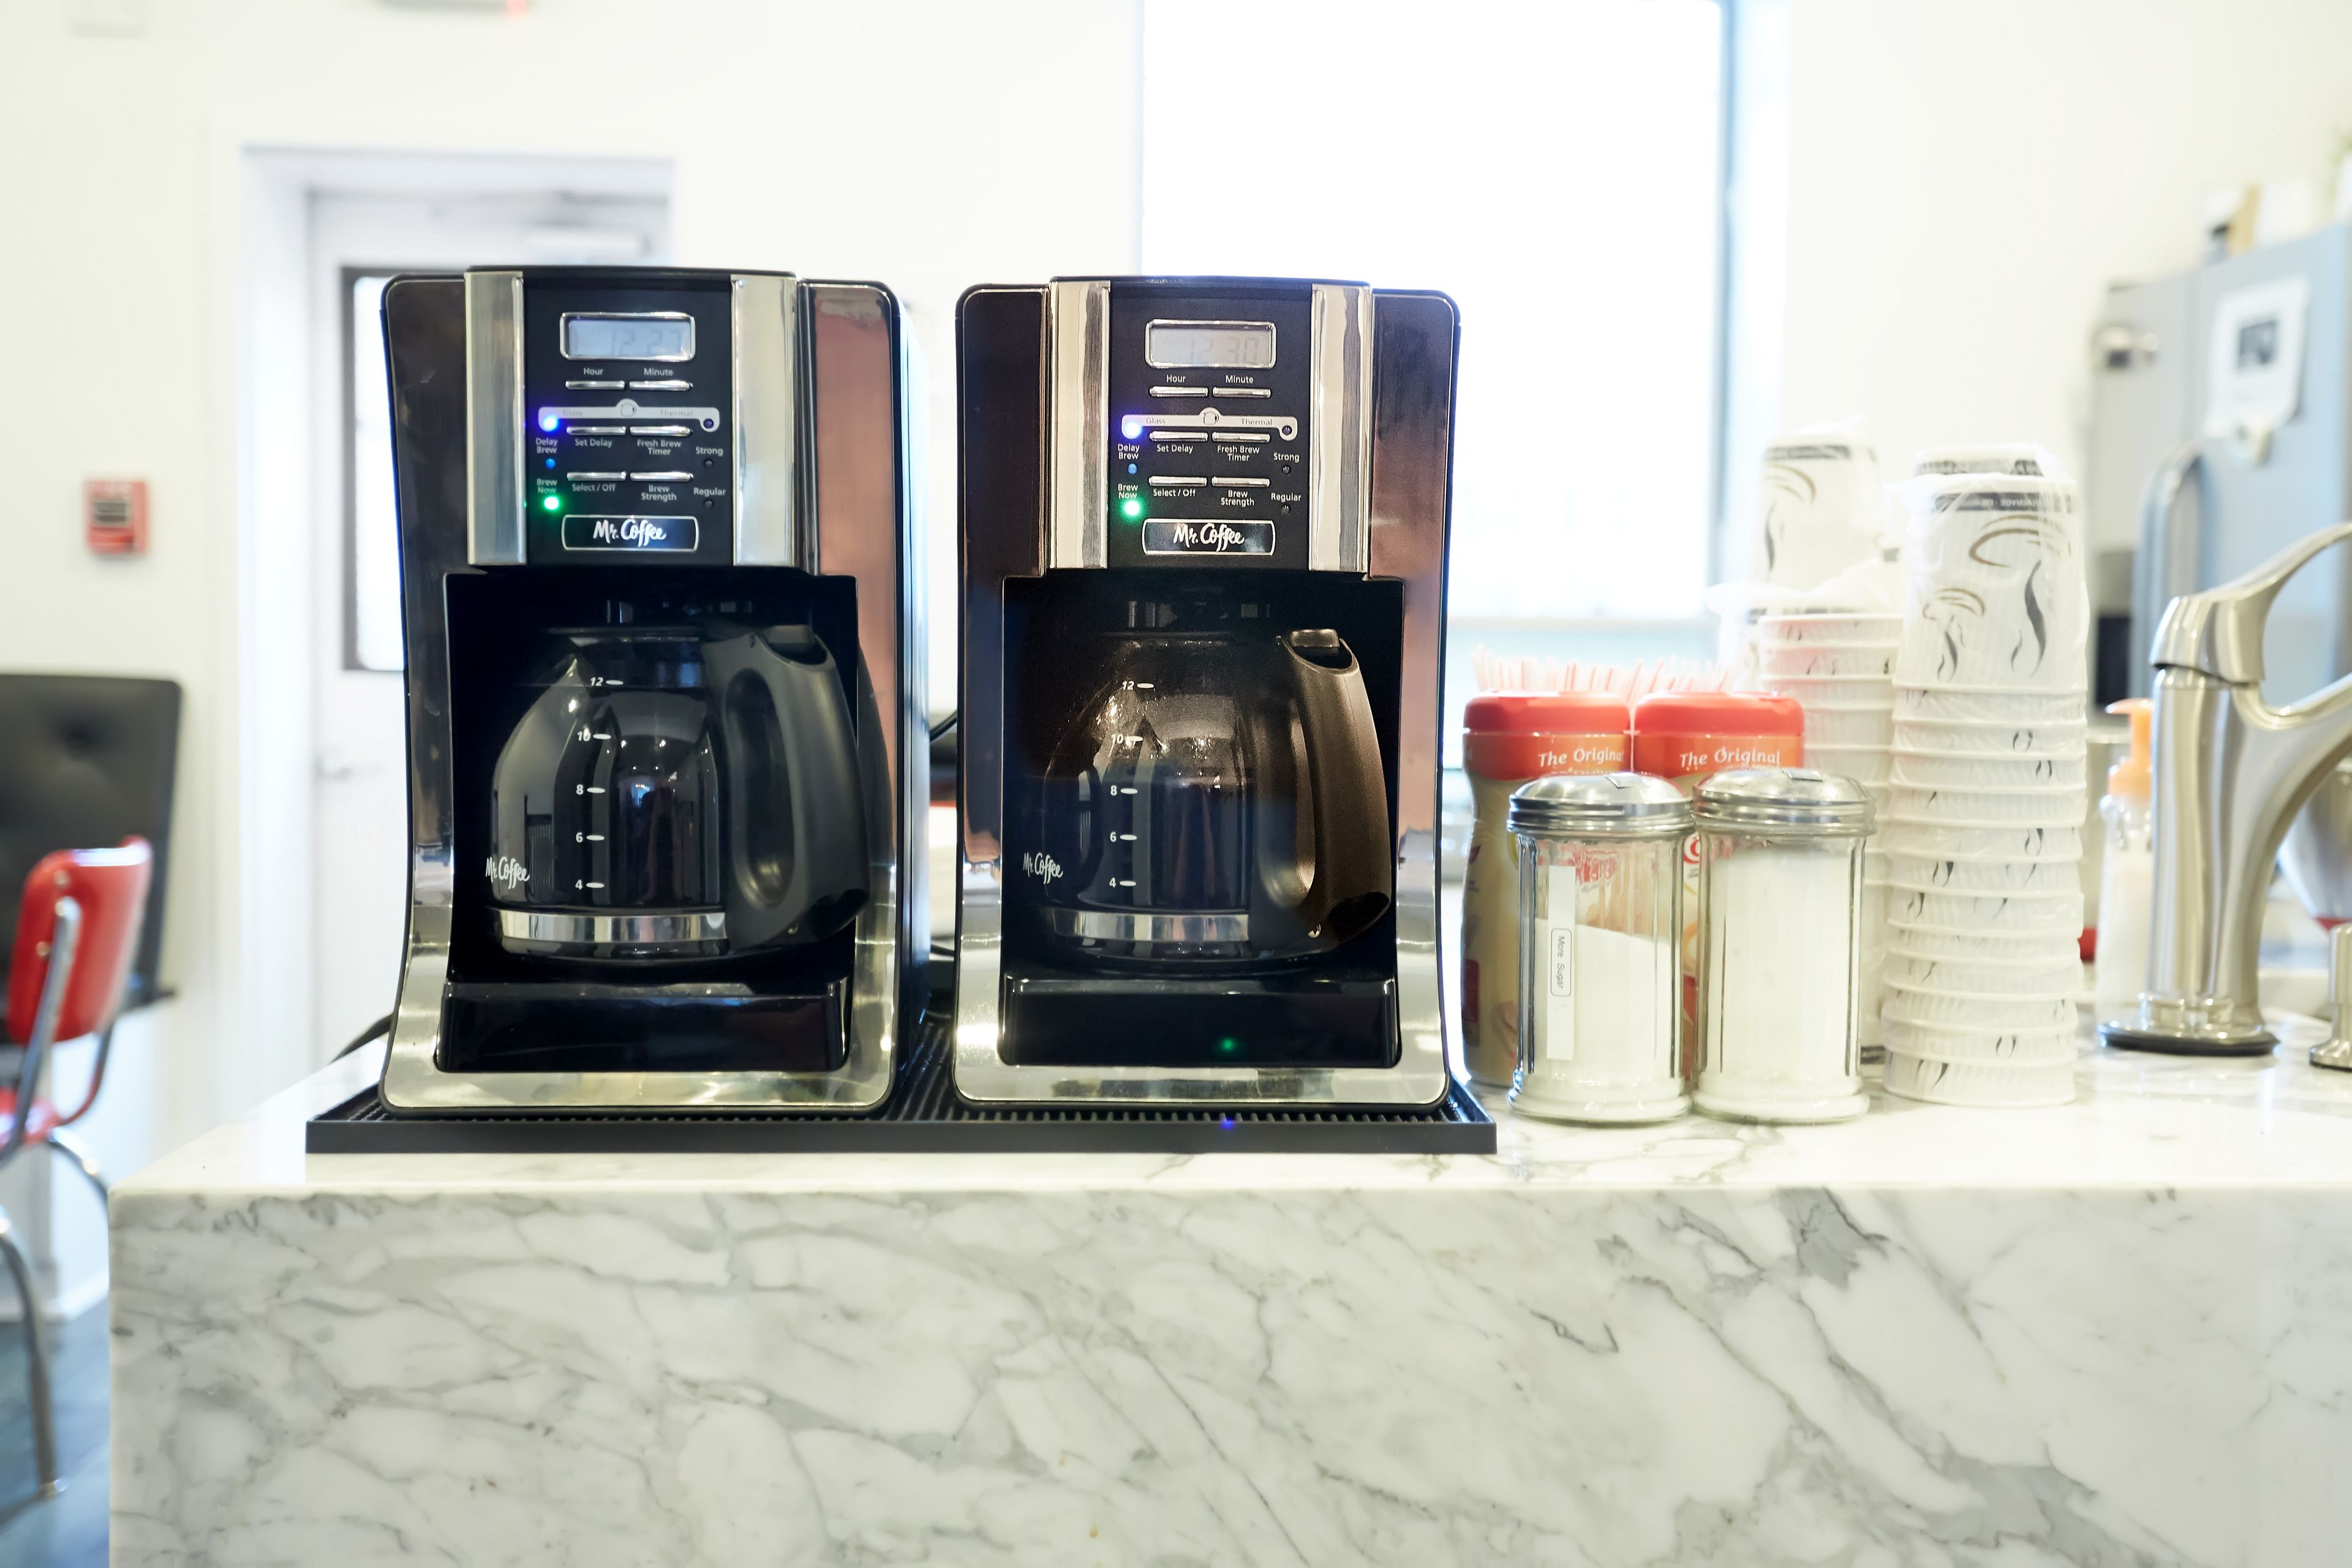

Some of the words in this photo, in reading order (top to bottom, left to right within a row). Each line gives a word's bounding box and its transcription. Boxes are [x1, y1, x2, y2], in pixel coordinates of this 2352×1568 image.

[1226, 375, 1253, 383] Minute
[536, 438, 557, 447] Delay
[590, 439, 612, 448] Delay
[696, 447, 723, 456] Strong
[1118, 443, 1139, 453] Delay
[1172, 444, 1193, 454] Delay
[1274, 453, 1299, 462] Strong
[641, 492, 676, 502] Strength
[694, 488, 725, 497] Regular
[1272, 493, 1301, 502] Regular
[1221, 497, 1254, 507] Strength
[621, 519, 667, 547] Coffee
[1200, 522, 1245, 552] Coffee
[591, 677, 603, 686] 12
[1122, 681, 1134, 690] 12
[578, 731, 590, 741] 10
[1111, 733, 1123, 744] 10
[1539, 752, 1567, 767] The
[1681, 752, 1708, 767] The
[1715, 747, 1780, 766] Original
[576, 785, 583, 794] 8
[1110, 785, 1117, 796] 8
[576, 832, 582, 842] 6
[1110, 832, 1116, 842] 6
[499, 856, 530, 889] Coffee
[1035, 853, 1063, 884] Coffee
[575, 880, 582, 889] 4
[1109, 878, 1116, 888] 4
[1556, 963, 1565, 989] Sugar
